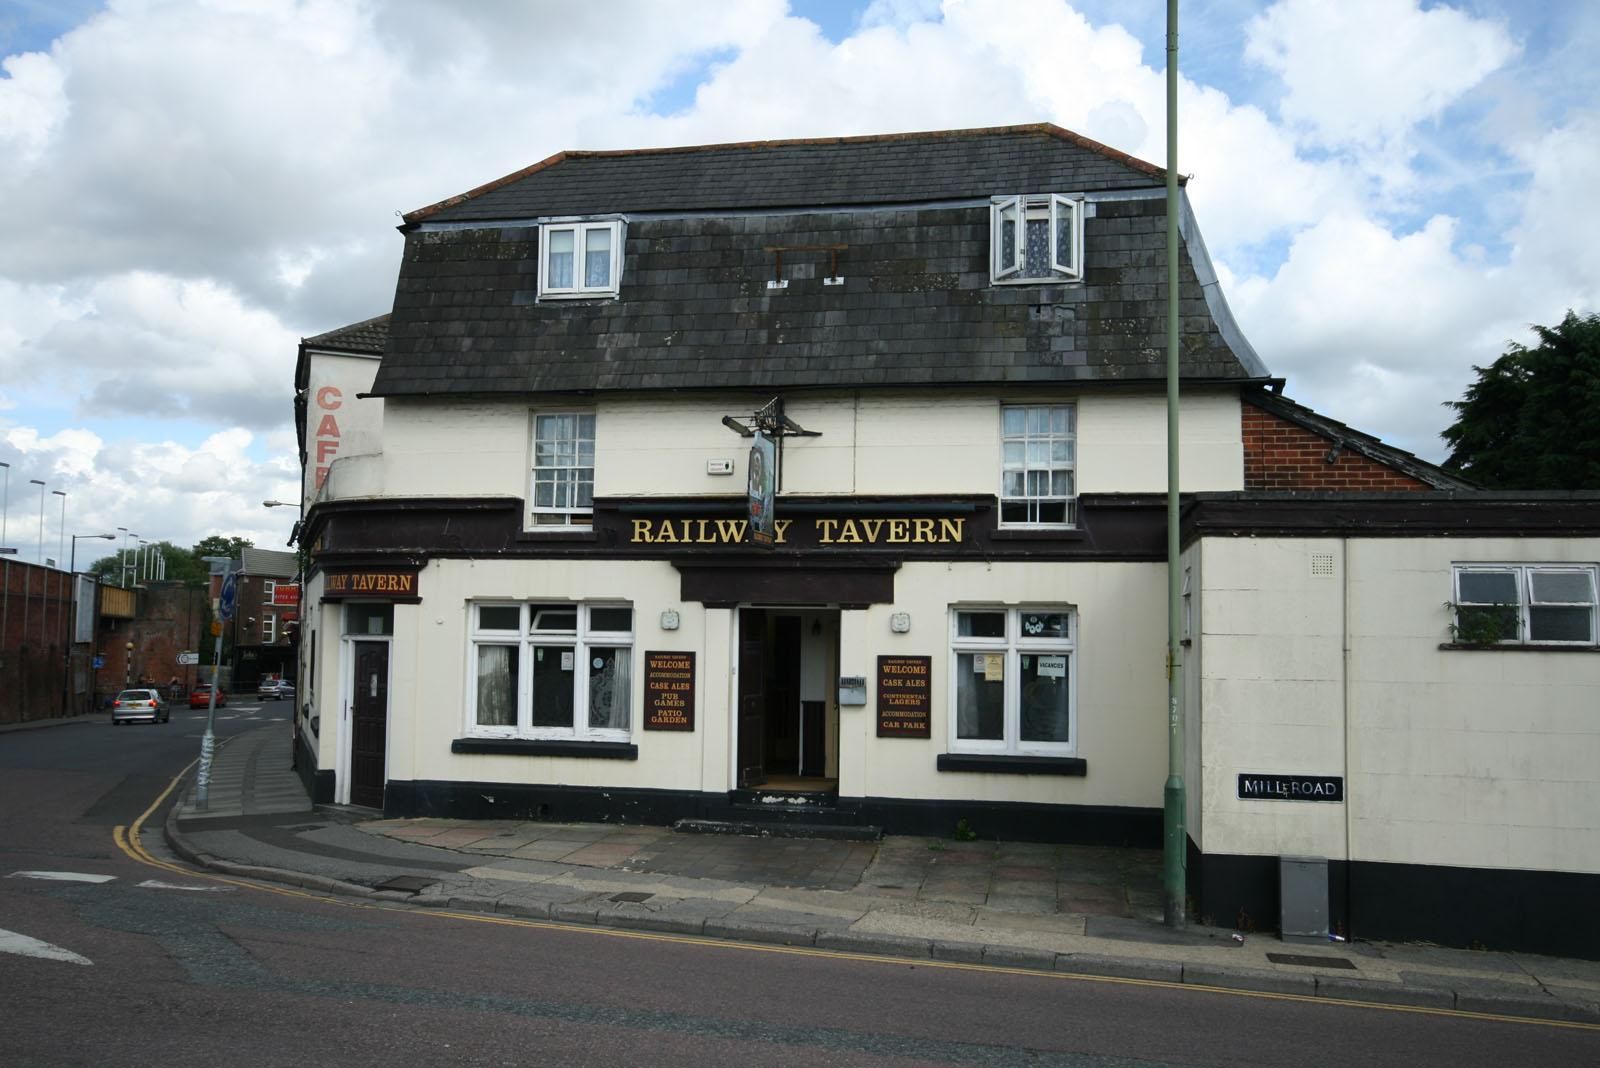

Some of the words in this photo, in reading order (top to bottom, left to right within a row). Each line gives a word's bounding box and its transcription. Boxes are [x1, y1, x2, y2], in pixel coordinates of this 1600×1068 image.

[630, 519, 793, 544] RAILWY
[816, 518, 966, 544] TAVERN
[352, 574, 412, 591] TAVERN
[650, 661, 691, 669] WELCOME
[882, 666, 926, 674] WELCOME
[650, 682, 669, 690] CASK
[883, 679, 903, 687] CASK
[905, 679, 926, 687] ALES
[654, 699, 685, 707] GAMES
[1244, 780, 1283, 794] MILL
[1291, 782, 1337, 795] ROAD
